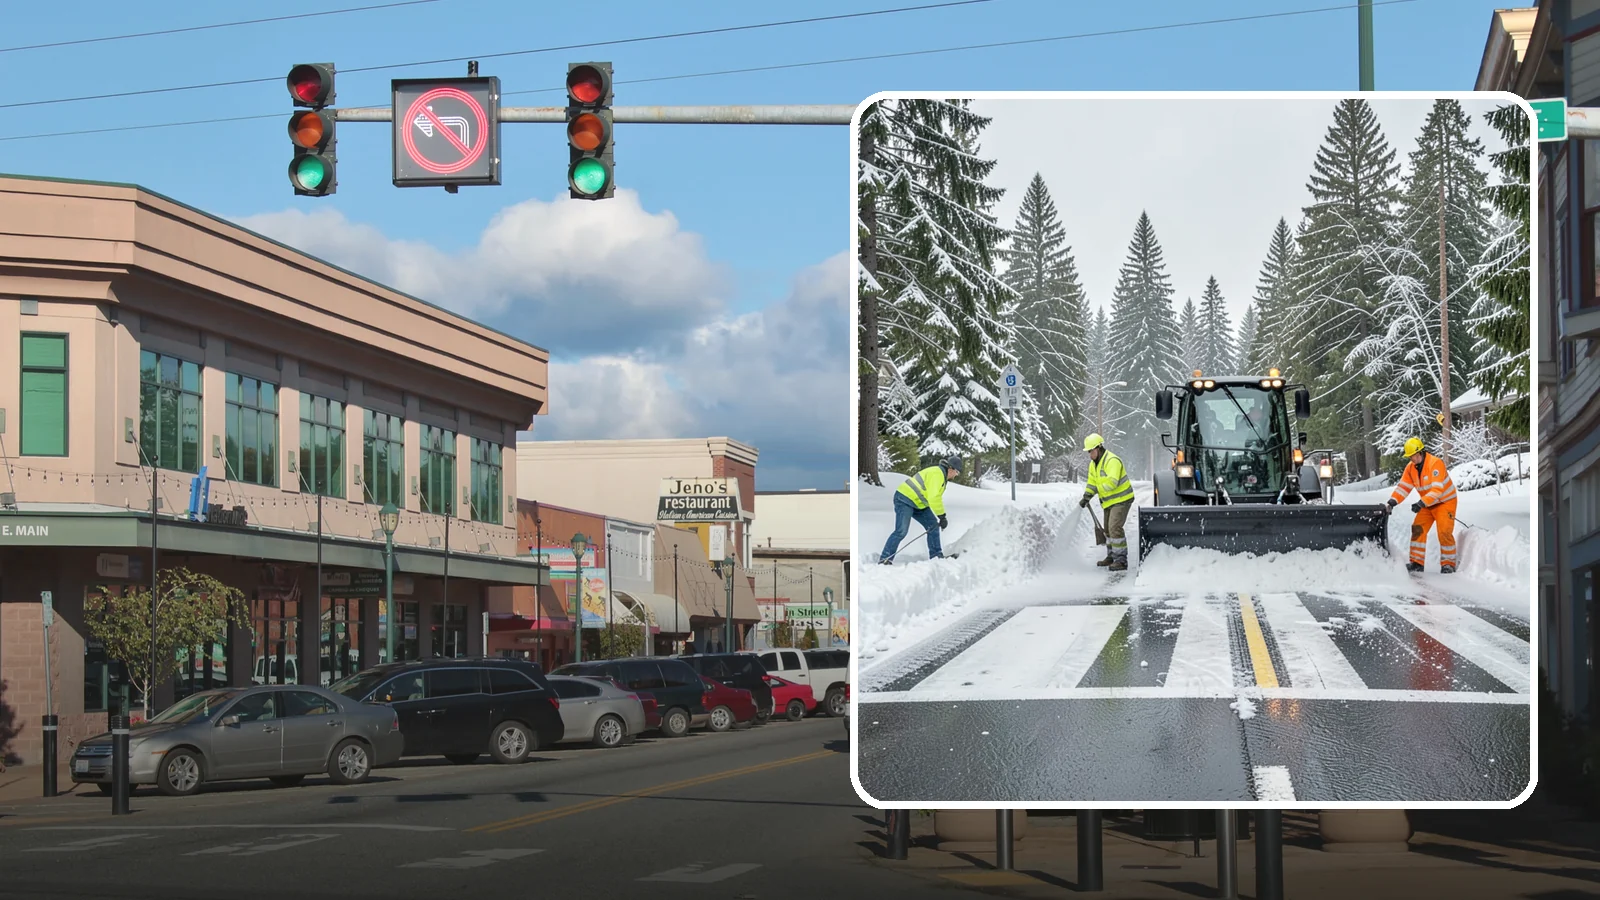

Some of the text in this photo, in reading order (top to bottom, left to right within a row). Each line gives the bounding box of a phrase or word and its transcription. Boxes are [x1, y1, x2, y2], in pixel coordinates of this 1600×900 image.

[670, 480, 727, 494] Jeno's
[665, 497, 730, 508] restaurant
[659, 510, 681, 519] Italian
[686, 510, 714, 519] American
[715, 510, 737, 518] Cuisine
[2, 525, 49, 536] E. MAIN
[797, 607, 828, 616] Street
